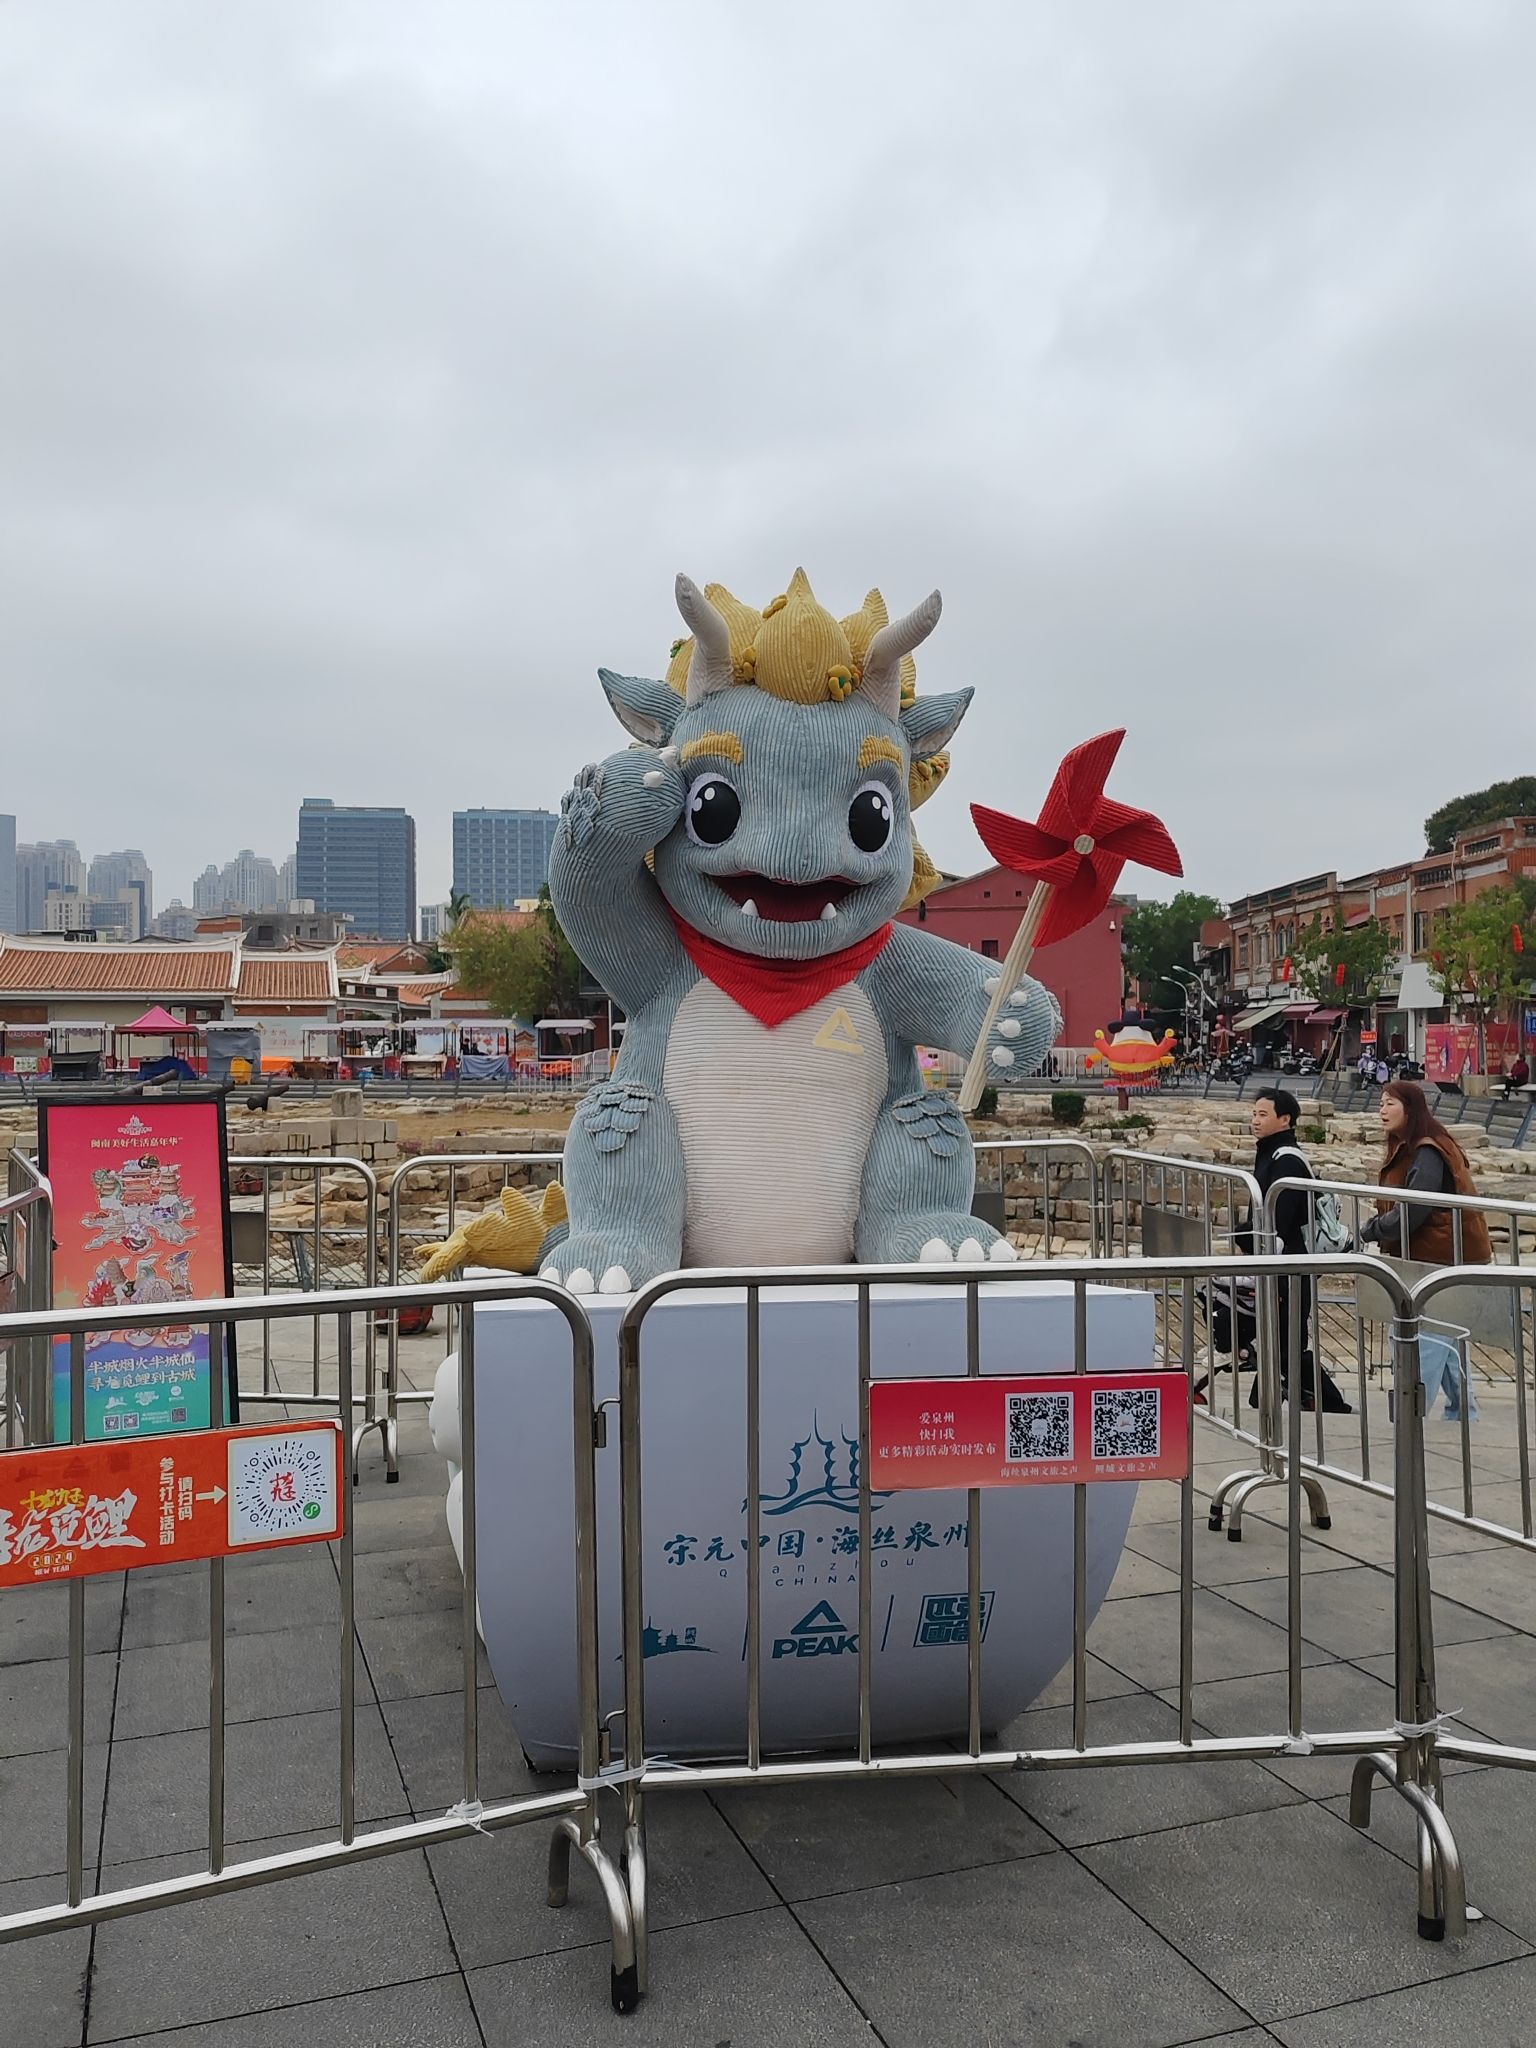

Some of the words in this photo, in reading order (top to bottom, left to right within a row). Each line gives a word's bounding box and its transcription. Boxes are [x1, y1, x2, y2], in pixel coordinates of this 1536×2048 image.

[87, 1352, 196, 1374] 半城烟火半城仙
[89, 1368, 197, 1391] 寻龙觅鲤到古城
[919, 1411, 955, 1424] 爱泉州
[919, 1427, 956, 1441] 快扫我
[879, 1442, 997, 1459] 更多精彩活动实时发布
[159, 1457, 175, 1545] 参与打卡活动
[32, 1551, 74, 1568] 2024
[34, 1568, 50, 1576] NEW
[52, 1566, 70, 1575] YEAR
[775, 1573, 856, 1587] CHINA
